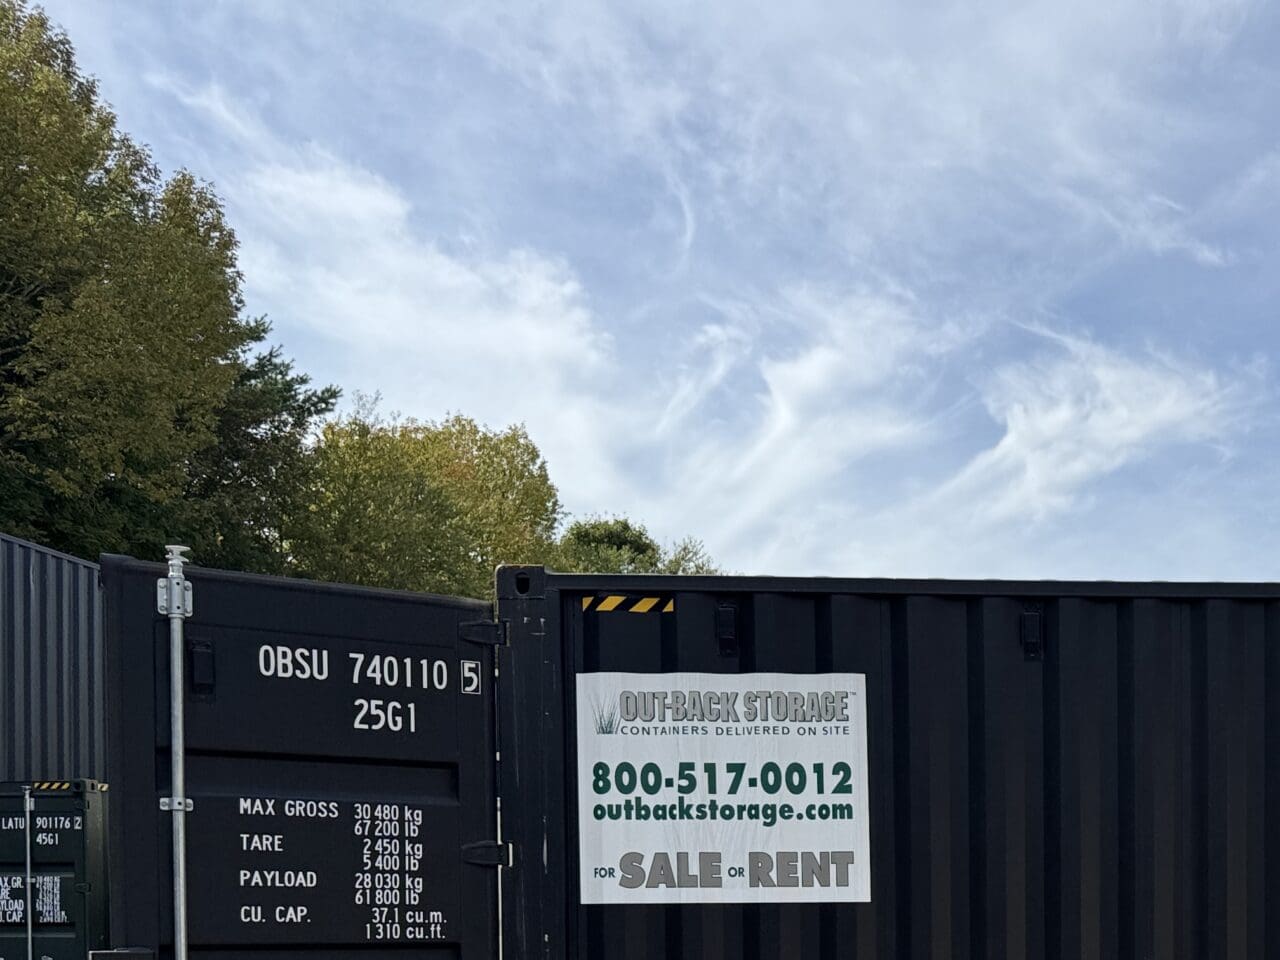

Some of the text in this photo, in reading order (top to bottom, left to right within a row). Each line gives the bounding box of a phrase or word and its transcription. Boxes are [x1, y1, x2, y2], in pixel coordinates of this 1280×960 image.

[258, 644, 481, 694] OBSU 740110 5
[353, 698, 416, 733] 25G1
[619, 690, 740, 722] OUT-BACK
[743, 690, 849, 722] STORAGE
[620, 725, 850, 736] CONTAINERS DELIVERED ON SITE
[592, 761, 853, 795] 800-517-0012
[239, 798, 422, 825] MAX GROSS 30 480 kg
[593, 796, 854, 826] outbackstorage.com
[2, 816, 82, 830] LATU 901176 2
[354, 820, 419, 837] 67 200 lb
[36, 833, 59, 845] 45G1
[240, 834, 284, 852] TARE
[374, 839, 400, 855] 450
[405, 840, 423, 859] kg
[374, 855, 400, 871] 400
[405, 854, 419, 871] lb
[594, 851, 855, 889] FOR SALE OR RENT
[239, 870, 423, 892] PAYLOAD 28 030 kg
[0, 899, 24, 911] YLOAD
[355, 889, 420, 905] 61 800 lb
[240, 906, 447, 924] CU. CAP. 37.1 cu.m.
[406, 924, 446, 939] cu.ft.
